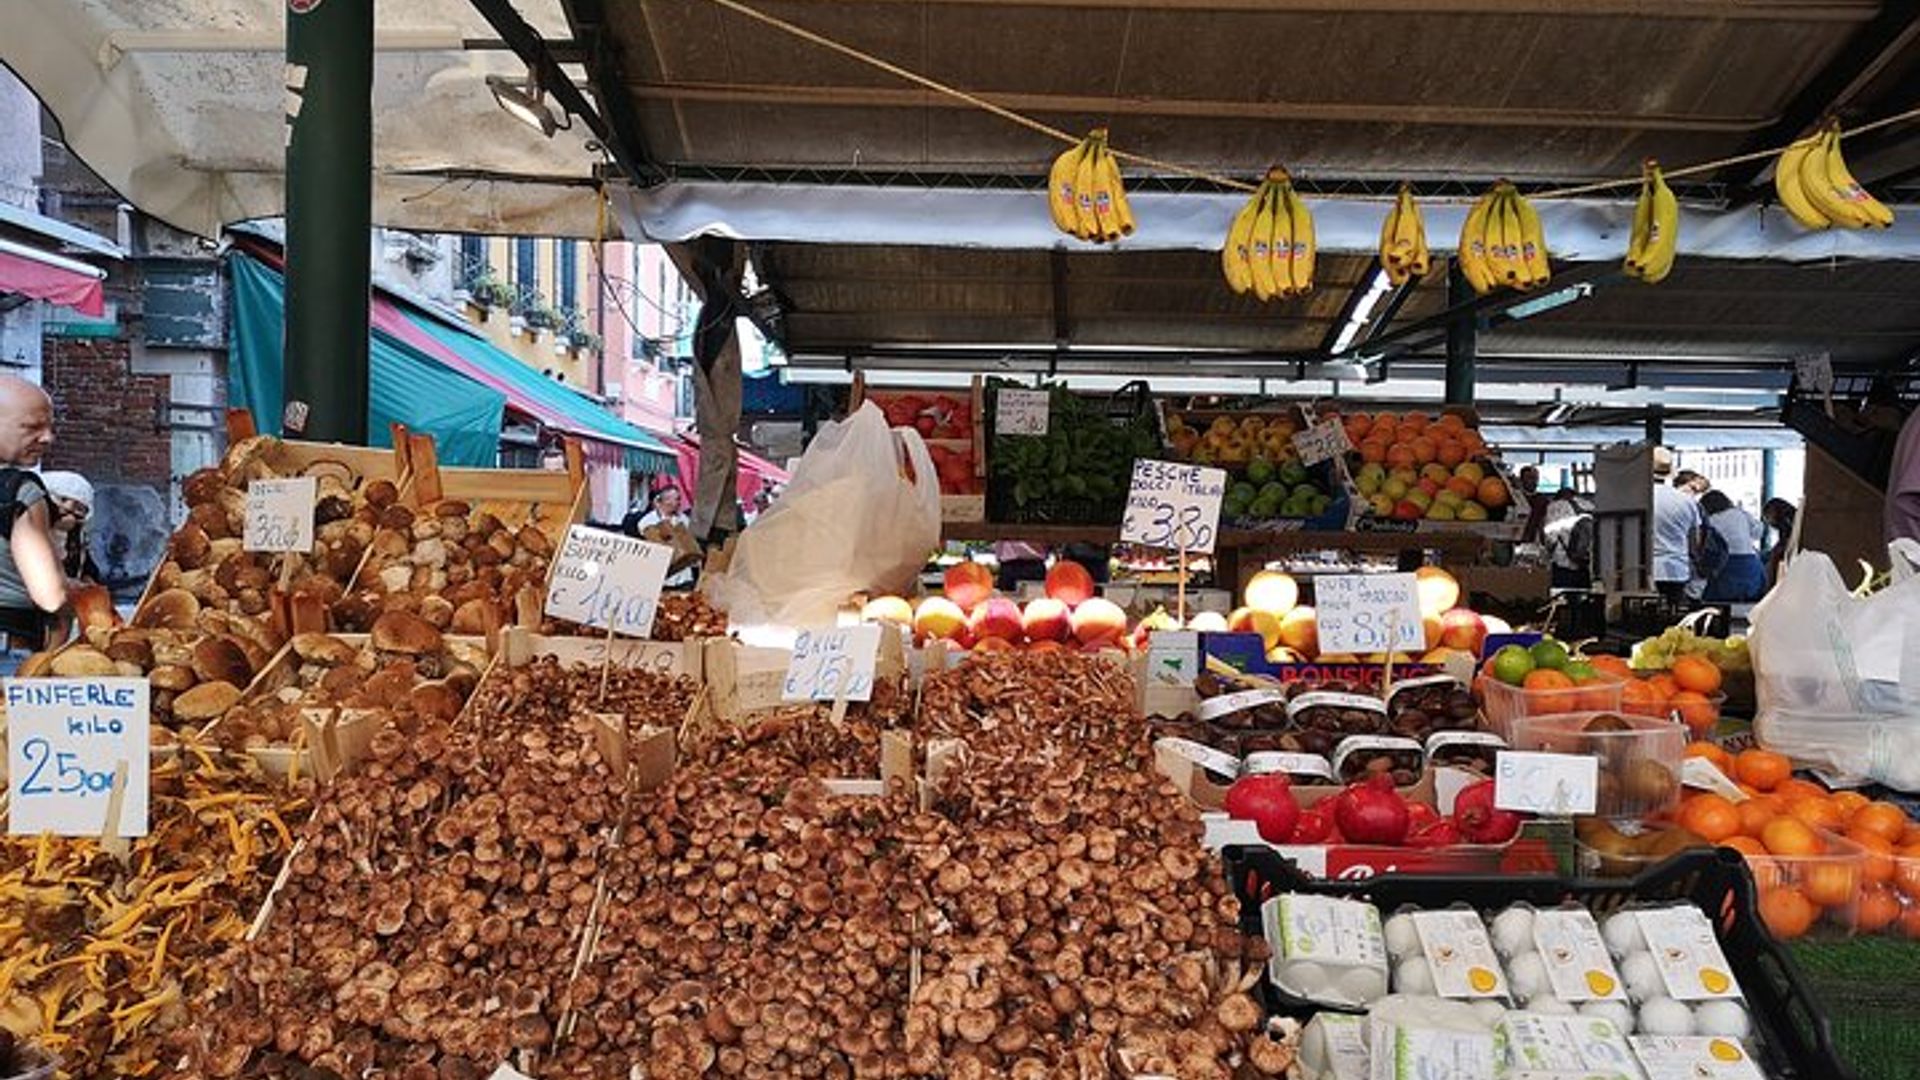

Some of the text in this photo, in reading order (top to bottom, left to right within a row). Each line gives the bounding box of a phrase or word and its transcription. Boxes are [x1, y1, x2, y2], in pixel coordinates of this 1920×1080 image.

[1135, 463, 1201, 482] PESCHE
[7, 684, 135, 707] FINFERLE
[66, 714, 124, 735] KILO
